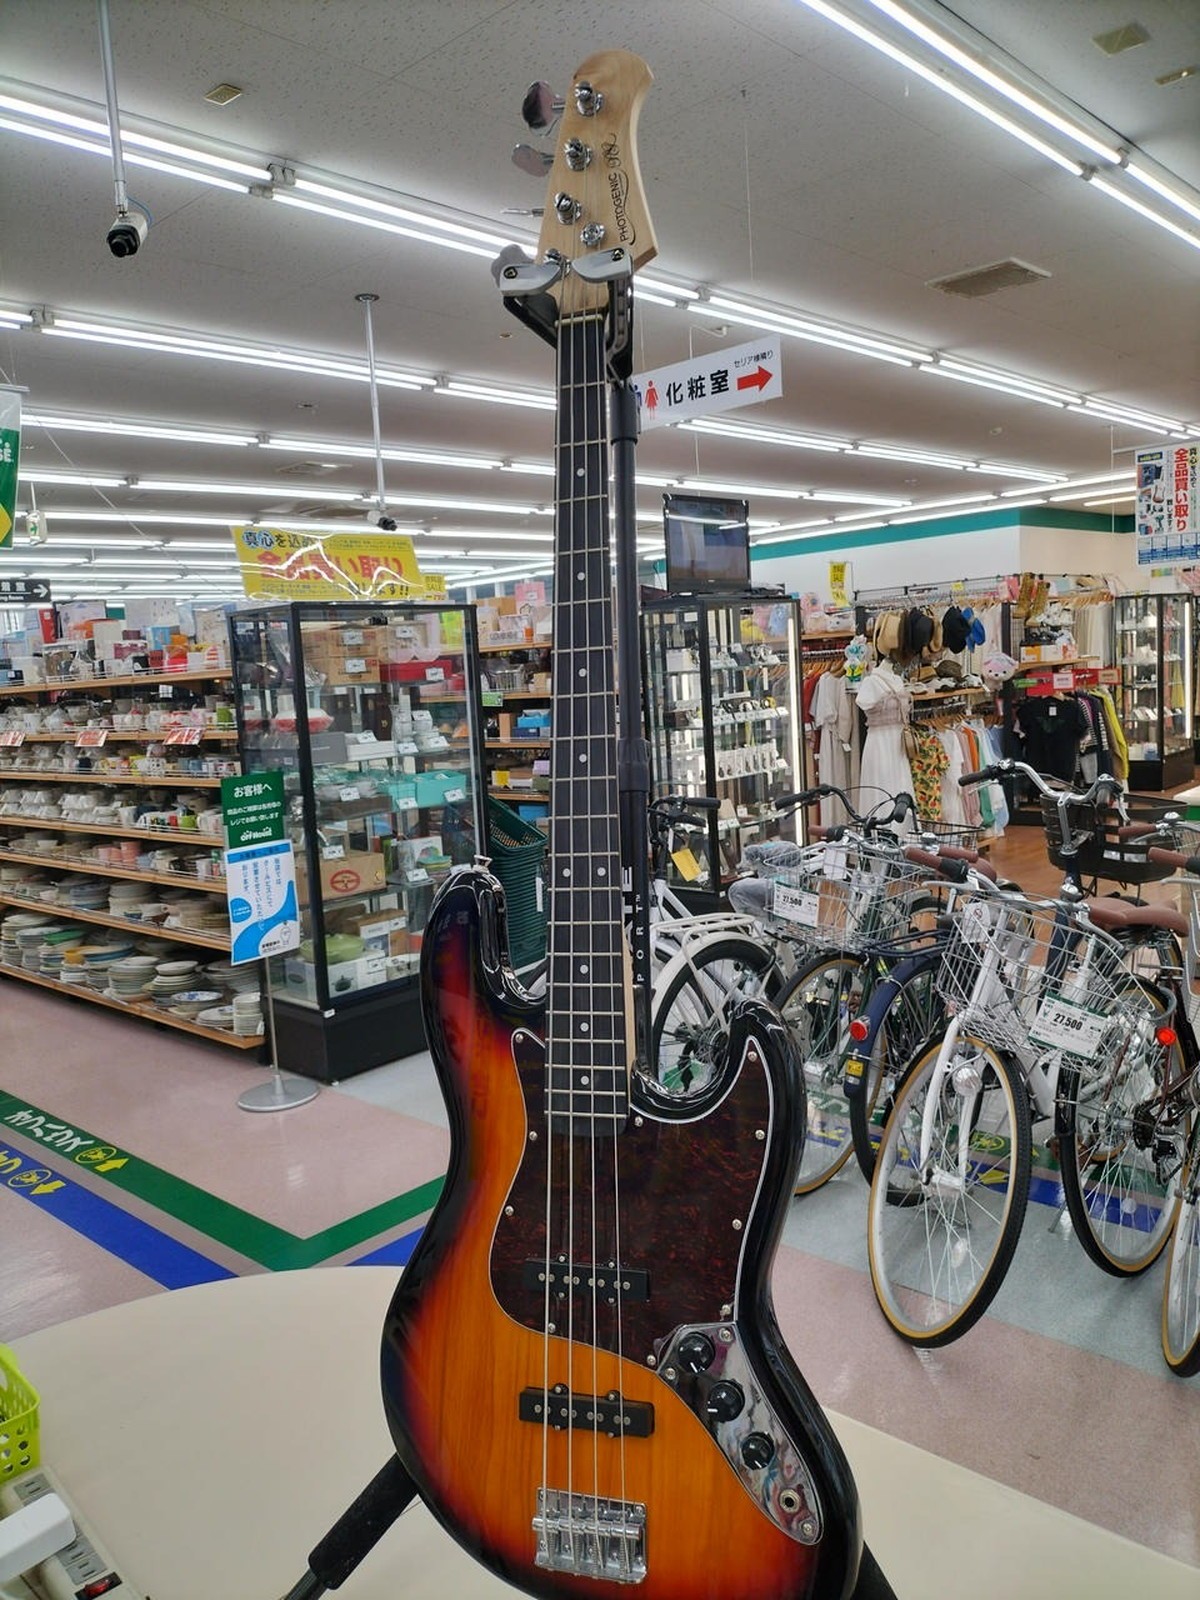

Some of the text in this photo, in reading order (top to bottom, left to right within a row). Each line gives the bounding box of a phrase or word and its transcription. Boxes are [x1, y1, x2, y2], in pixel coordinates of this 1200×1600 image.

[608, 172, 629, 242] PHOTOGENIC
[666, 369, 730, 407] 化粧室
[1174, 447, 1189, 532] 全品買い取り
[234, 783, 272, 798] お客様へ
[1053, 1012, 1084, 1031] 27,500
[3, 1109, 96, 1152] オフハウス
